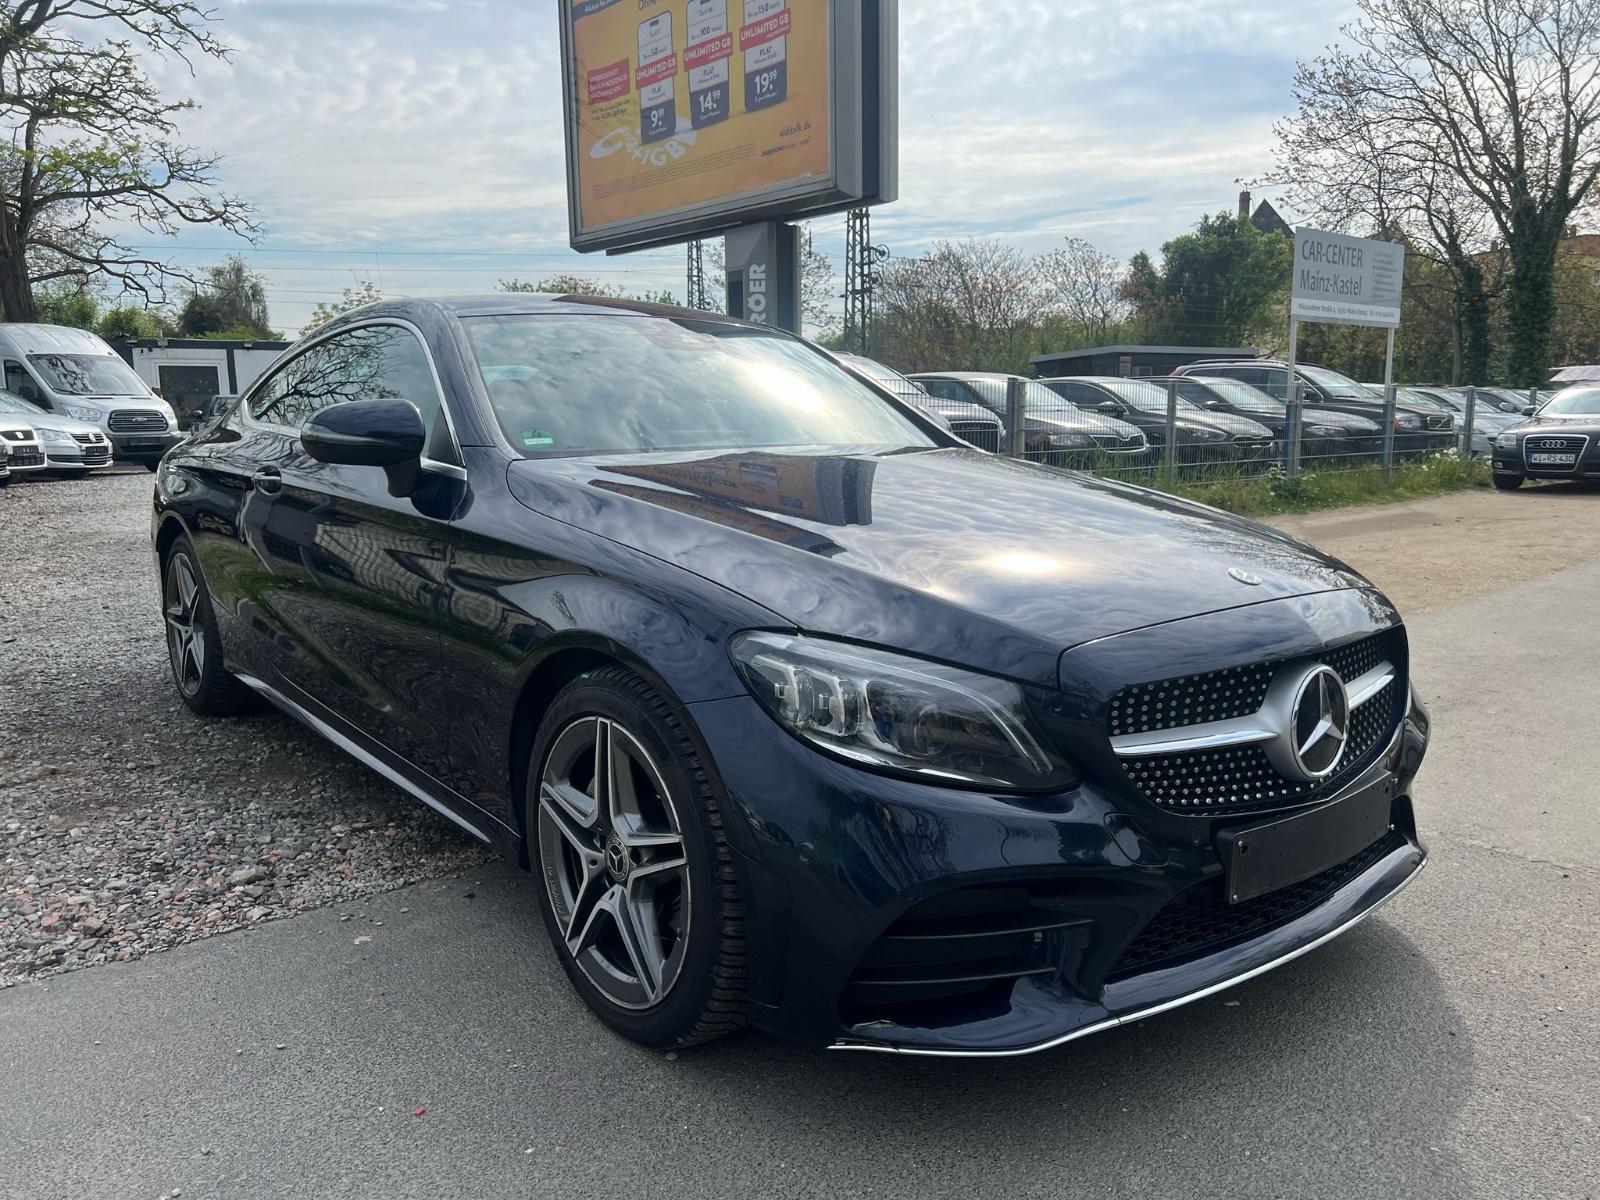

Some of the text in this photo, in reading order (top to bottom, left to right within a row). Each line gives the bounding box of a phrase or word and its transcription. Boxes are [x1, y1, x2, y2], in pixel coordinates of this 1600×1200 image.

[740, 18, 778, 40] UNLIMITED
[778, 13, 789, 25] GB
[684, 41, 720, 61] UNLIMITED
[721, 37, 731, 48] GB
[759, 46, 772, 57] FLAT
[637, 61, 666, 80] UNLIMITED
[1301, 240, 1363, 268] CAR-CENTER
[1300, 270, 1362, 296] Mainz-Kastel
